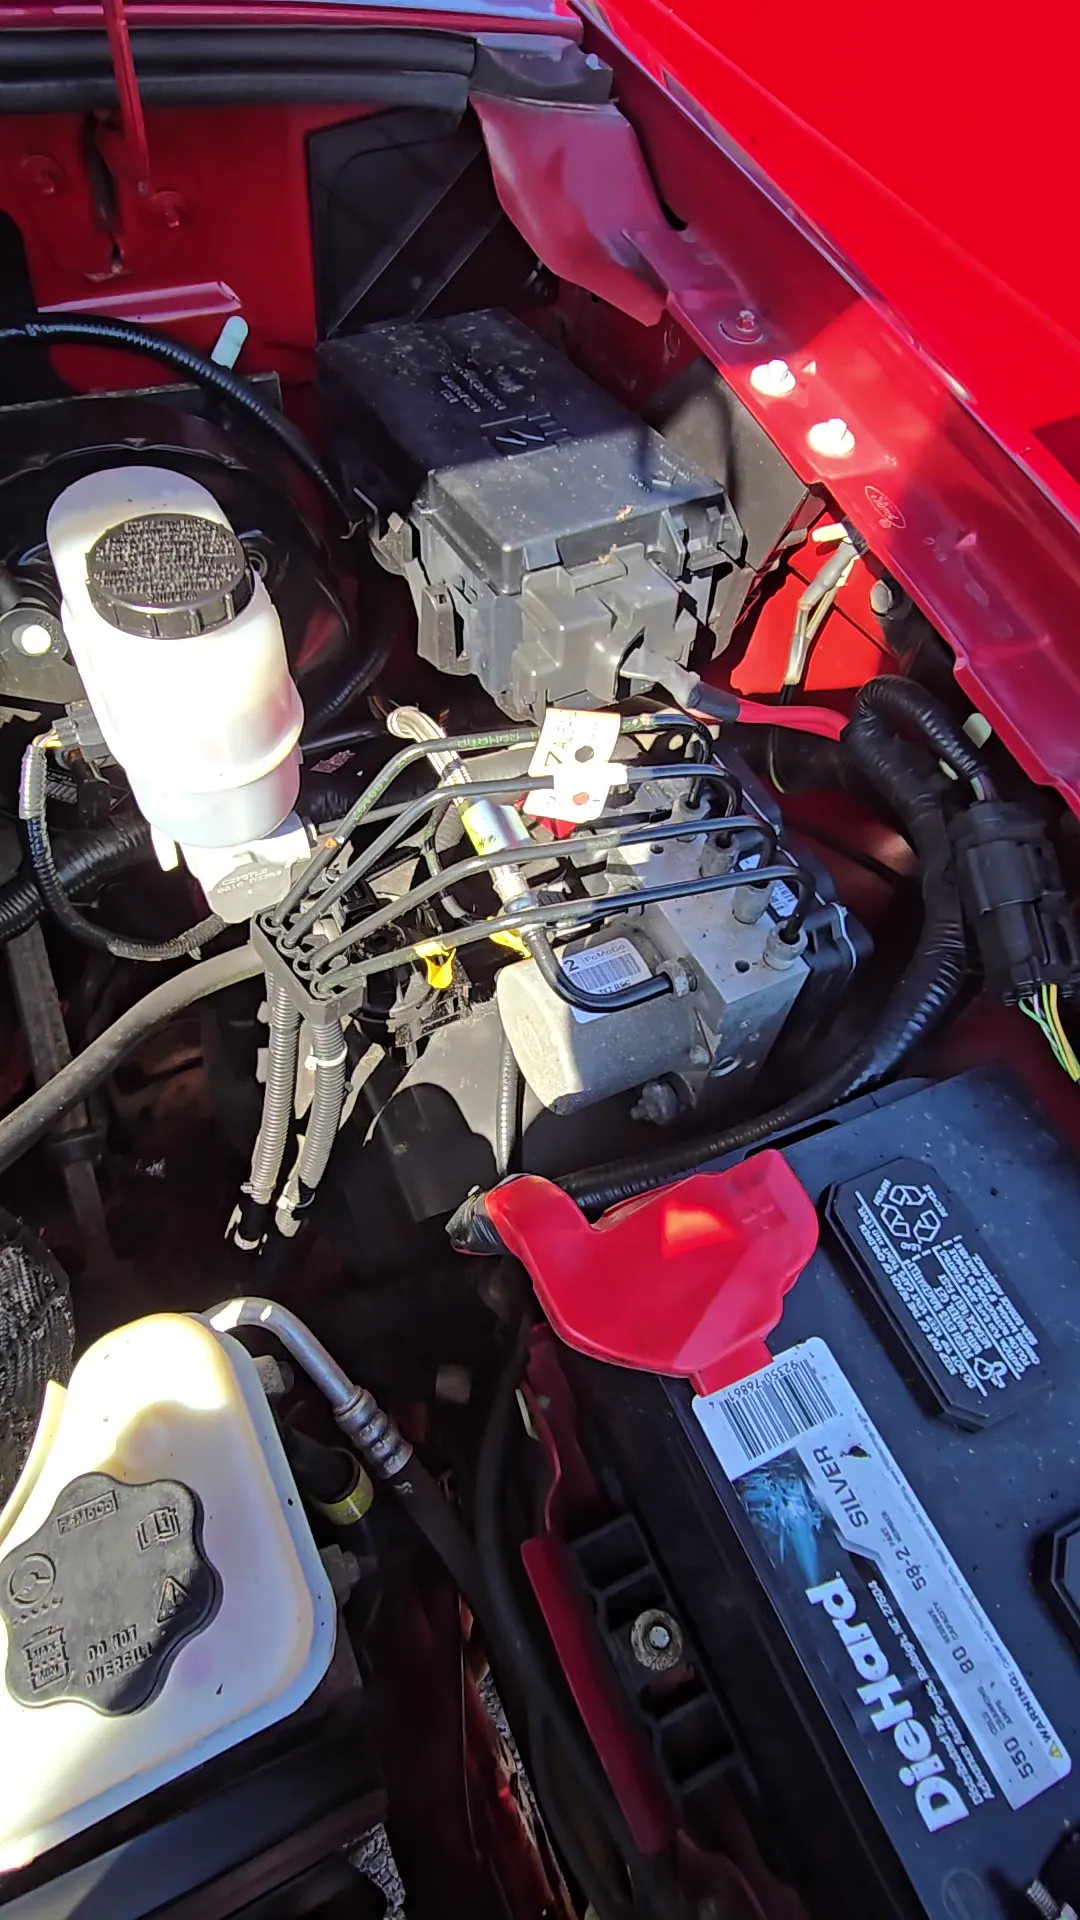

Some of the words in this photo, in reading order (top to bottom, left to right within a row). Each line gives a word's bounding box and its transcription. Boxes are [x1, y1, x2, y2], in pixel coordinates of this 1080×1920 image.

[563, 959, 579, 971] 2
[921, 1182, 949, 1218] RECYCLE
[856, 1205, 875, 1229] LEVEL
[858, 1222, 886, 1262] CHILDREN
[870, 1228, 885, 1246] AND
[901, 1242, 920, 1251] LEAD
[881, 1245, 900, 1271] TIGHT
[881, 1260, 894, 1275] OF
[889, 1273, 911, 1302] REACH
[896, 1269, 915, 1293] CAPS
[906, 1259, 943, 1312] IMMEDIATELY
[932, 1283, 950, 1304] GET
[936, 1271, 956, 1295] FAST
[976, 1275, 991, 1294] NOT
[906, 1300, 922, 1319] THE
[910, 1290, 928, 1315] VENT
[950, 1291, 969, 1315] HELP
[917, 1317, 931, 1333] OF
[924, 1313, 943, 1337] KEEP
[937, 1309, 957, 1333] EYES
[964, 1313, 992, 1350] MEDICAL
[925, 1330, 943, 1352] OUT
[950, 1329, 974, 1360] FLUSH
[962, 1330, 983, 1355] WITH
[1005, 1333, 1031, 1367] FOLLOW
[762, 1357, 799, 1383] 92350
[938, 1350, 958, 1375] KEEP
[950, 1353, 966, 1374] NOT
[726, 1377, 761, 1402] 76861
[961, 1372, 976, 1389] DO
[810, 1443, 870, 1530] SILVER
[879, 1525, 896, 1547] PART
[893, 1545, 928, 1591] 58-2
[866, 1578, 894, 1618] 27604
[887, 1615, 904, 1635] NC
[931, 1600, 959, 1641] CAPACITY
[86, 1639, 107, 1663] DO
[111, 1623, 137, 1648] NOT
[84, 1642, 152, 1688] OVERFILL
[950, 1644, 976, 1674] 80
[803, 1571, 970, 1832] DieHard
[976, 1685, 1006, 1730] CRANKING
[994, 1699, 1014, 1725] AMPS
[1004, 1670, 1054, 1744] WARNING:
[941, 1714, 966, 1746] Auto
[938, 1733, 985, 1806] Distributed
[1001, 1735, 1036, 1779] 550
[958, 1744, 996, 1800] Advance
